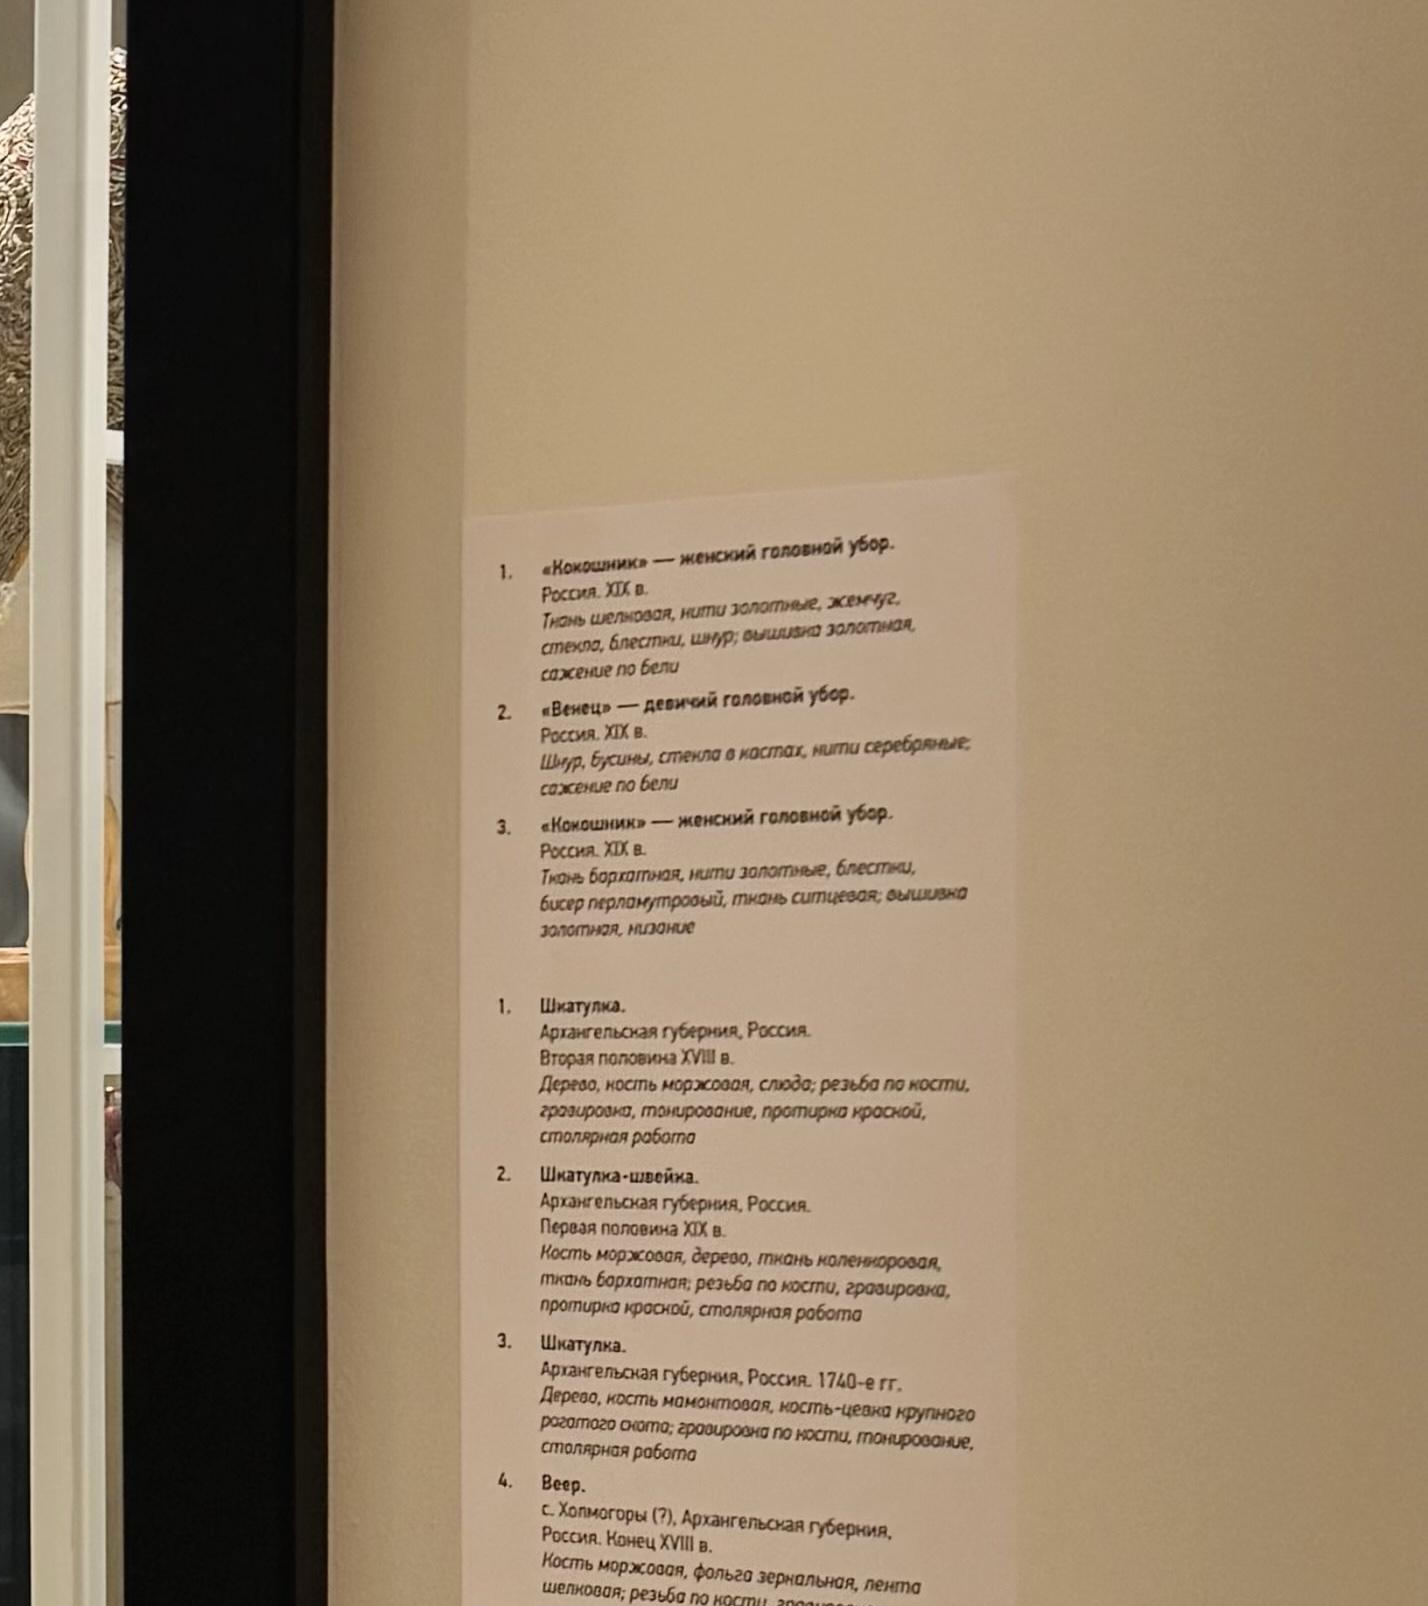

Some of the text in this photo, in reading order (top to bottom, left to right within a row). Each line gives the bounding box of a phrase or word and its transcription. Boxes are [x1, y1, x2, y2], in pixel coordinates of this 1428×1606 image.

[499, 533, 896, 581] 1. «Кокошник» женский головной убор.
[540, 585, 601, 604] Россия.
[604, 579, 631, 599] XIX
[496, 683, 855, 721] 2. «Венец» девичий головной убор.
[539, 726, 600, 745] Россия.
[603, 722, 630, 741] XIX
[496, 802, 894, 836] 3. «Кокошник» женский головной убор.
[498, 996, 627, 1018] 1. Шкатулка.
[661, 1020, 744, 1044] губерния,
[746, 1019, 812, 1039] Россия.
[539, 1047, 595, 1070] Вторая
[597, 1051, 678, 1067] половина
[679, 1047, 716, 1066] XVIII
[538, 1126, 697, 1149] столярная работа
[496, 1164, 512, 1182] 2.
[539, 1216, 597, 1239] Первая
[600, 1222, 679, 1238] половина
[682, 1219, 708, 1238] XIX
[496, 1331, 627, 1357] 3. Шкатулка.
[661, 1364, 744, 1388] губерния,
[747, 1367, 813, 1388] Россия.
[817, 1370, 876, 1391] 1740-е
[878, 1376, 903, 1393] гг.
[496, 1471, 586, 1497] 4. Веер.
[557, 1500, 648, 1526] Холмогоры
[807, 1516, 893, 1541] губерния,
[540, 1550, 922, 1596] Кость моржовая, фольга зеркальная, лента
[541, 1580, 627, 1602] шелковая;
[628, 1585, 687, 1605] резьба
[688, 1591, 710, 1606] по
